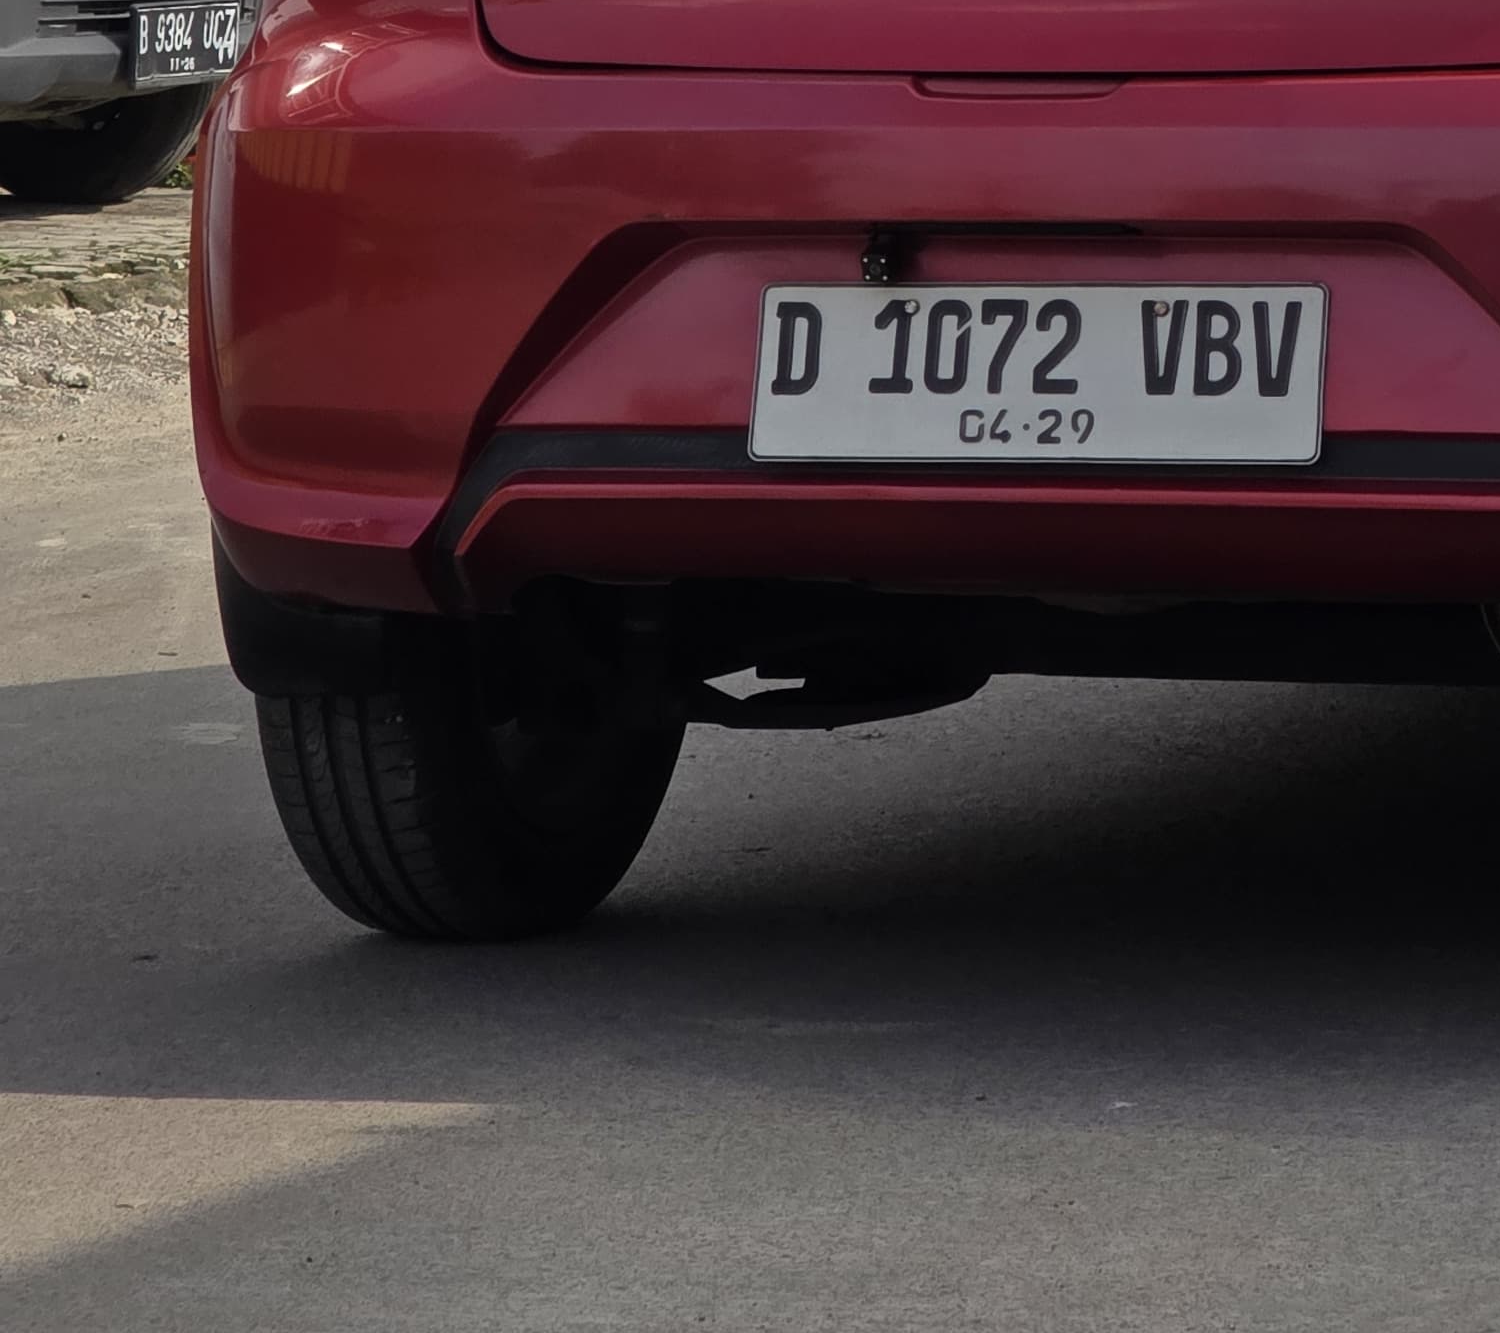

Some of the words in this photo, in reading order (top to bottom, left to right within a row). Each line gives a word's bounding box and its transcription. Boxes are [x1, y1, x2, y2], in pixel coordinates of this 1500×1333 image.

[139, 15, 148, 55] B
[155, 11, 195, 53] 9384
[771, 301, 822, 396] D
[868, 298, 1082, 396] 1072
[1141, 299, 1303, 397] VBV
